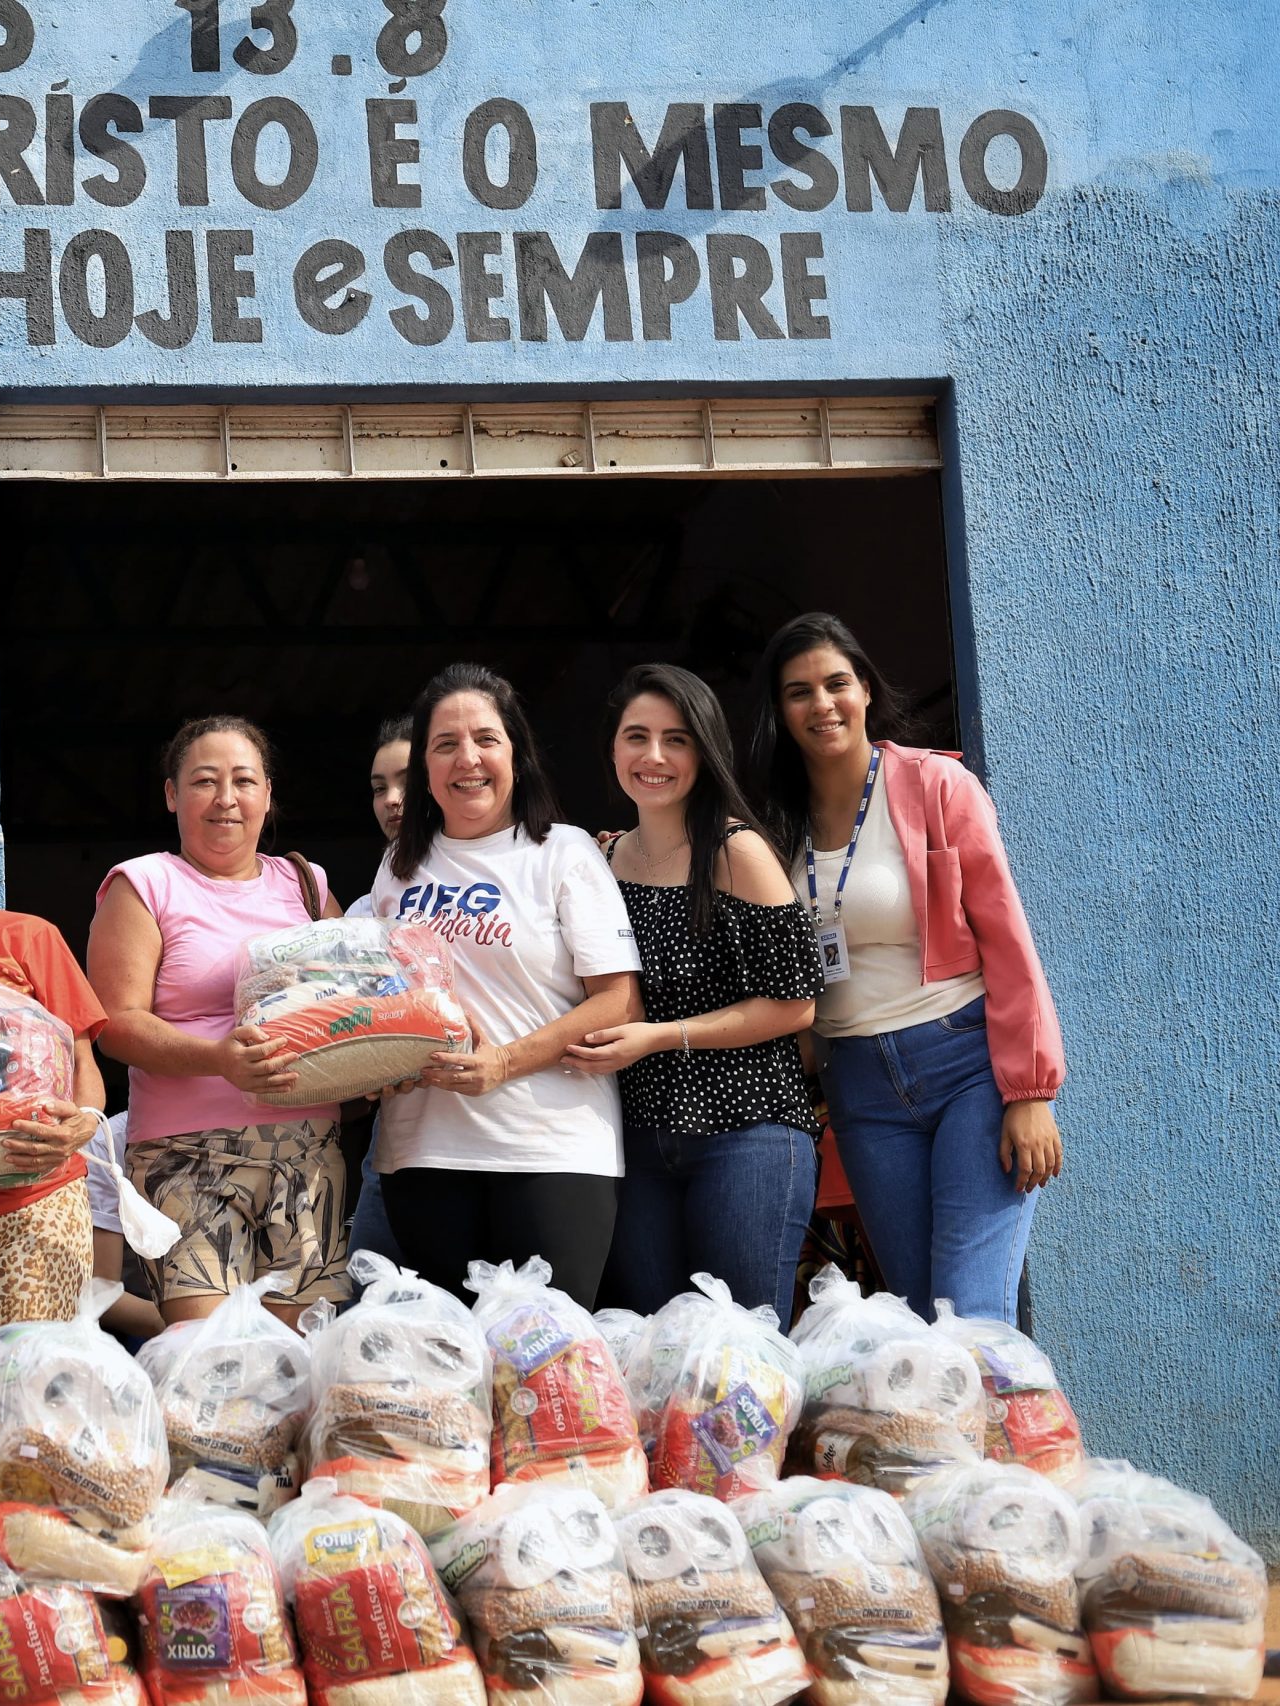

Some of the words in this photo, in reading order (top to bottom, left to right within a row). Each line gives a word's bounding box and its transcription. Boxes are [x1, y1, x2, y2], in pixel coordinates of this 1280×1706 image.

[366, 77, 423, 209] É
[463, 97, 538, 211] O
[590, 101, 1048, 216] MESMO
[396, 882, 502, 920] FIEG
[408, 905, 513, 948] lidária
[521, 1329, 563, 1362] SOTRIX
[736, 1394, 772, 1438] SOTRIX
[61, 1467, 82, 1483] CINCO
[80, 1477, 113, 1501] ESTRELAS
[442, 1538, 488, 1592] aradiso
[321, 1597, 336, 1637] Massas
[329, 1583, 369, 1672] SAFRA
[367, 1584, 394, 1662] Parafuso
[861, 1608, 883, 1618] CINCO
[882, 1608, 913, 1619] ESTRELAS
[22, 1609, 53, 1687] Parafuso
[167, 1644, 216, 1660] SOTRIX
